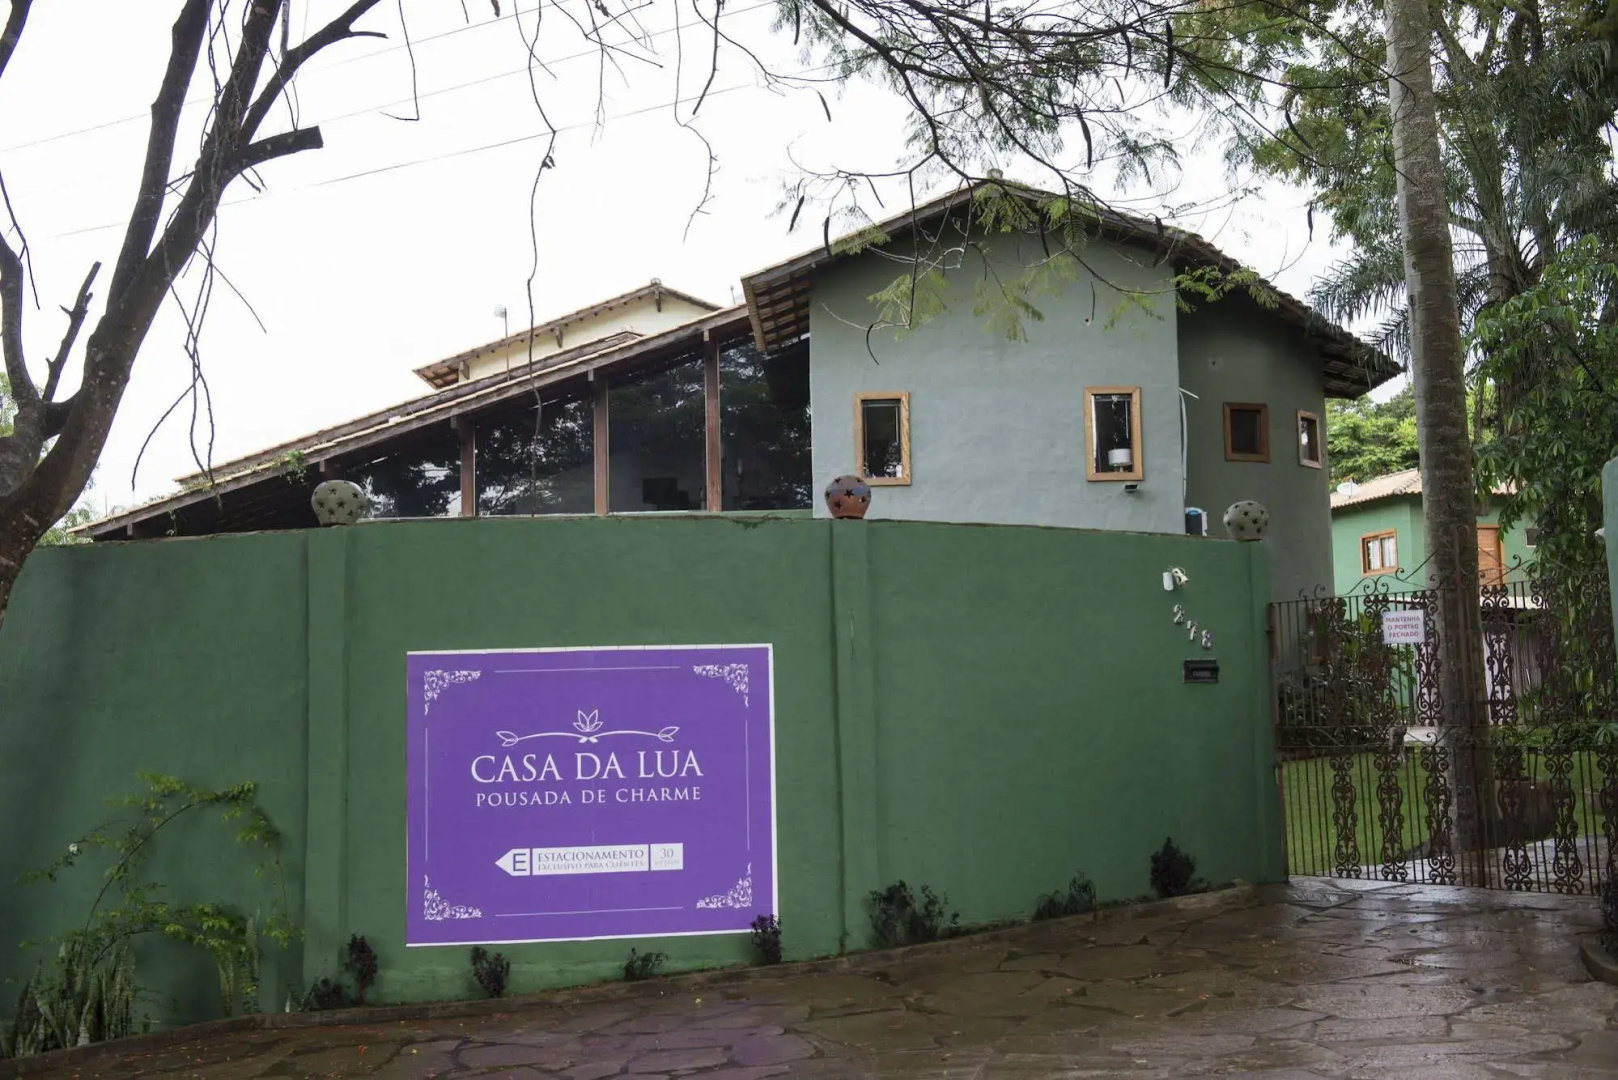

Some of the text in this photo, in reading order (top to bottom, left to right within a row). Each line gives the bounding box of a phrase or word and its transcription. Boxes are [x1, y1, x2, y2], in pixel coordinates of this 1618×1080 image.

[471, 749, 704, 783] CASA DA LUA
[476, 786, 701, 807] POUSADA DE CHARME
[538, 849, 644, 862] ESTACIONAMENTO
[660, 848, 674, 859] 30
[512, 852, 527, 872] E
[538, 863, 583, 871] EXCLUSIVO
[605, 860, 644, 869] CLIENTES
